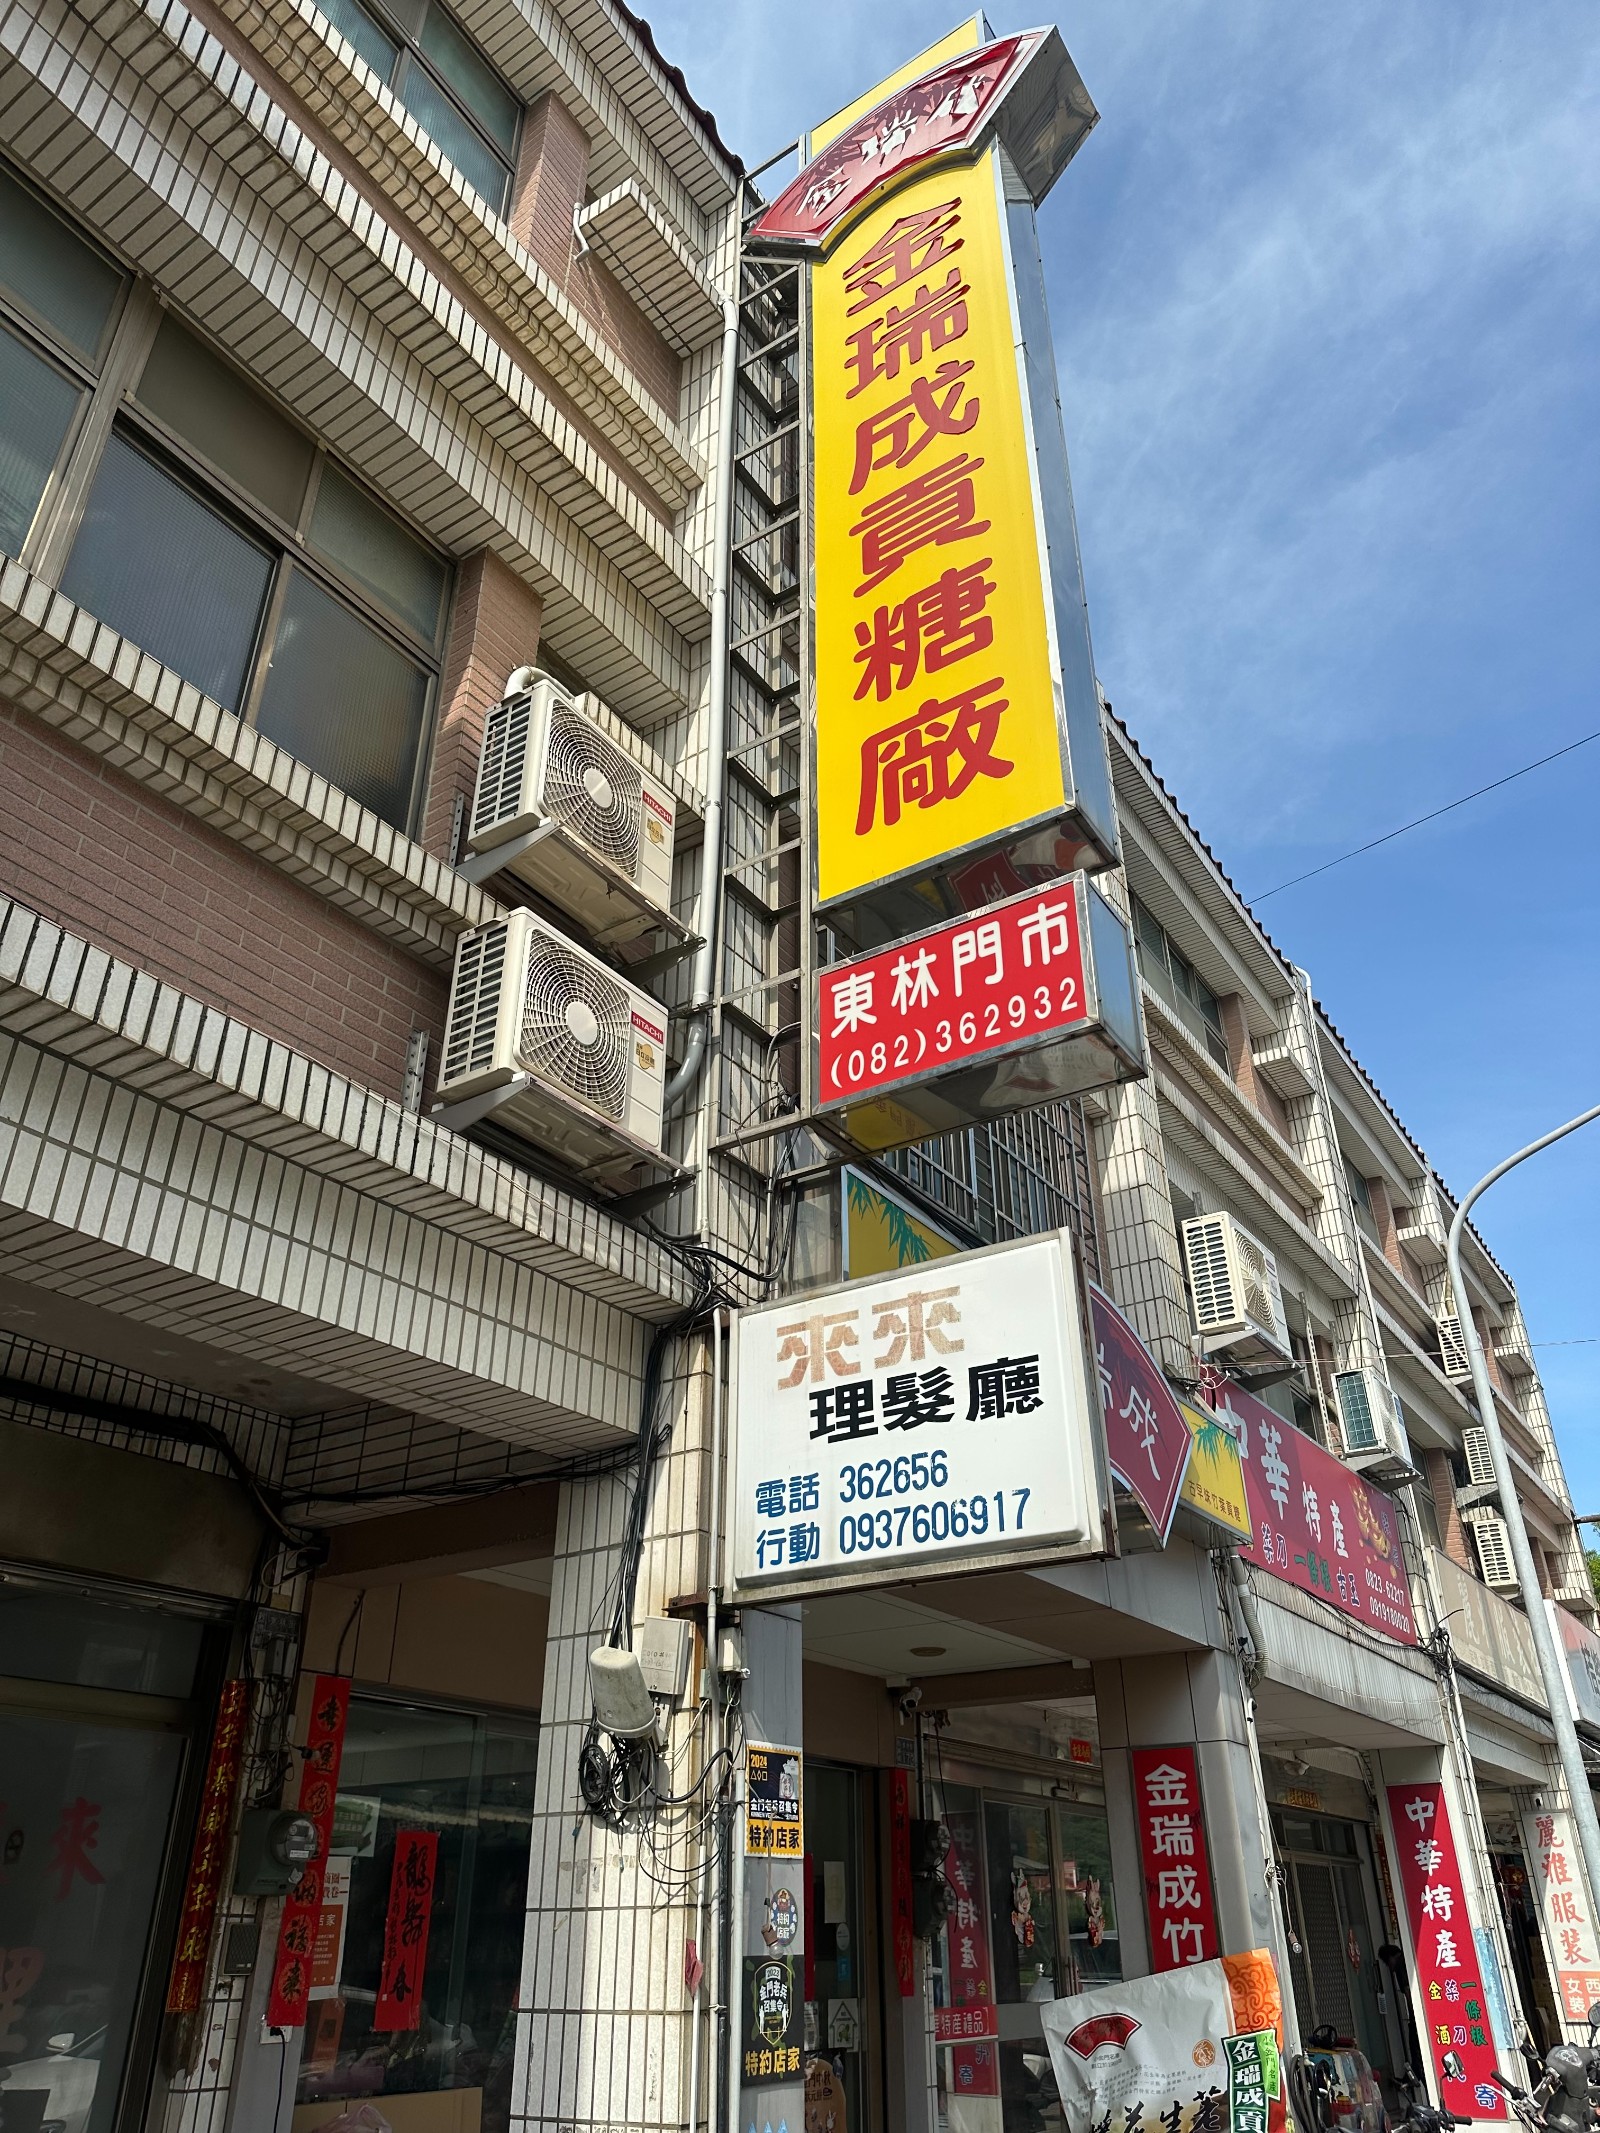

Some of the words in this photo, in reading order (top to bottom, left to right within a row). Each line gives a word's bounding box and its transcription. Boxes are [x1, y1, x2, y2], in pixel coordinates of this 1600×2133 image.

[843, 197, 1014, 835] 金瑞成貢糖廠
[644, 794, 671, 823] HITACHI
[830, 901, 1070, 1039] 東林門市
[633, 1015, 662, 1041] HITACHI
[831, 977, 1078, 1088] (082)362932
[776, 1286, 965, 1391] 來來
[809, 1354, 1044, 1443] 理髮廳
[755, 1472, 820, 1518] 電話
[839, 1450, 949, 1504] 362656
[756, 1521, 820, 1569] 行動
[839, 1489, 1032, 1553] 0937606917
[750, 1754, 768, 1768] 2024
[749, 1823, 800, 1849] 特約店家
[1144, 1764, 1204, 1963] 金瑞成竹
[1404, 1797, 1462, 1968] 中華特產
[1535, 1815, 1592, 1965] 麗雅服裝
[759, 1979, 788, 2001] 金門老兵
[763, 1999, 784, 2014] 召集令
[766, 1968, 780, 1979] 2023
[745, 2047, 800, 2077] 特約店家
